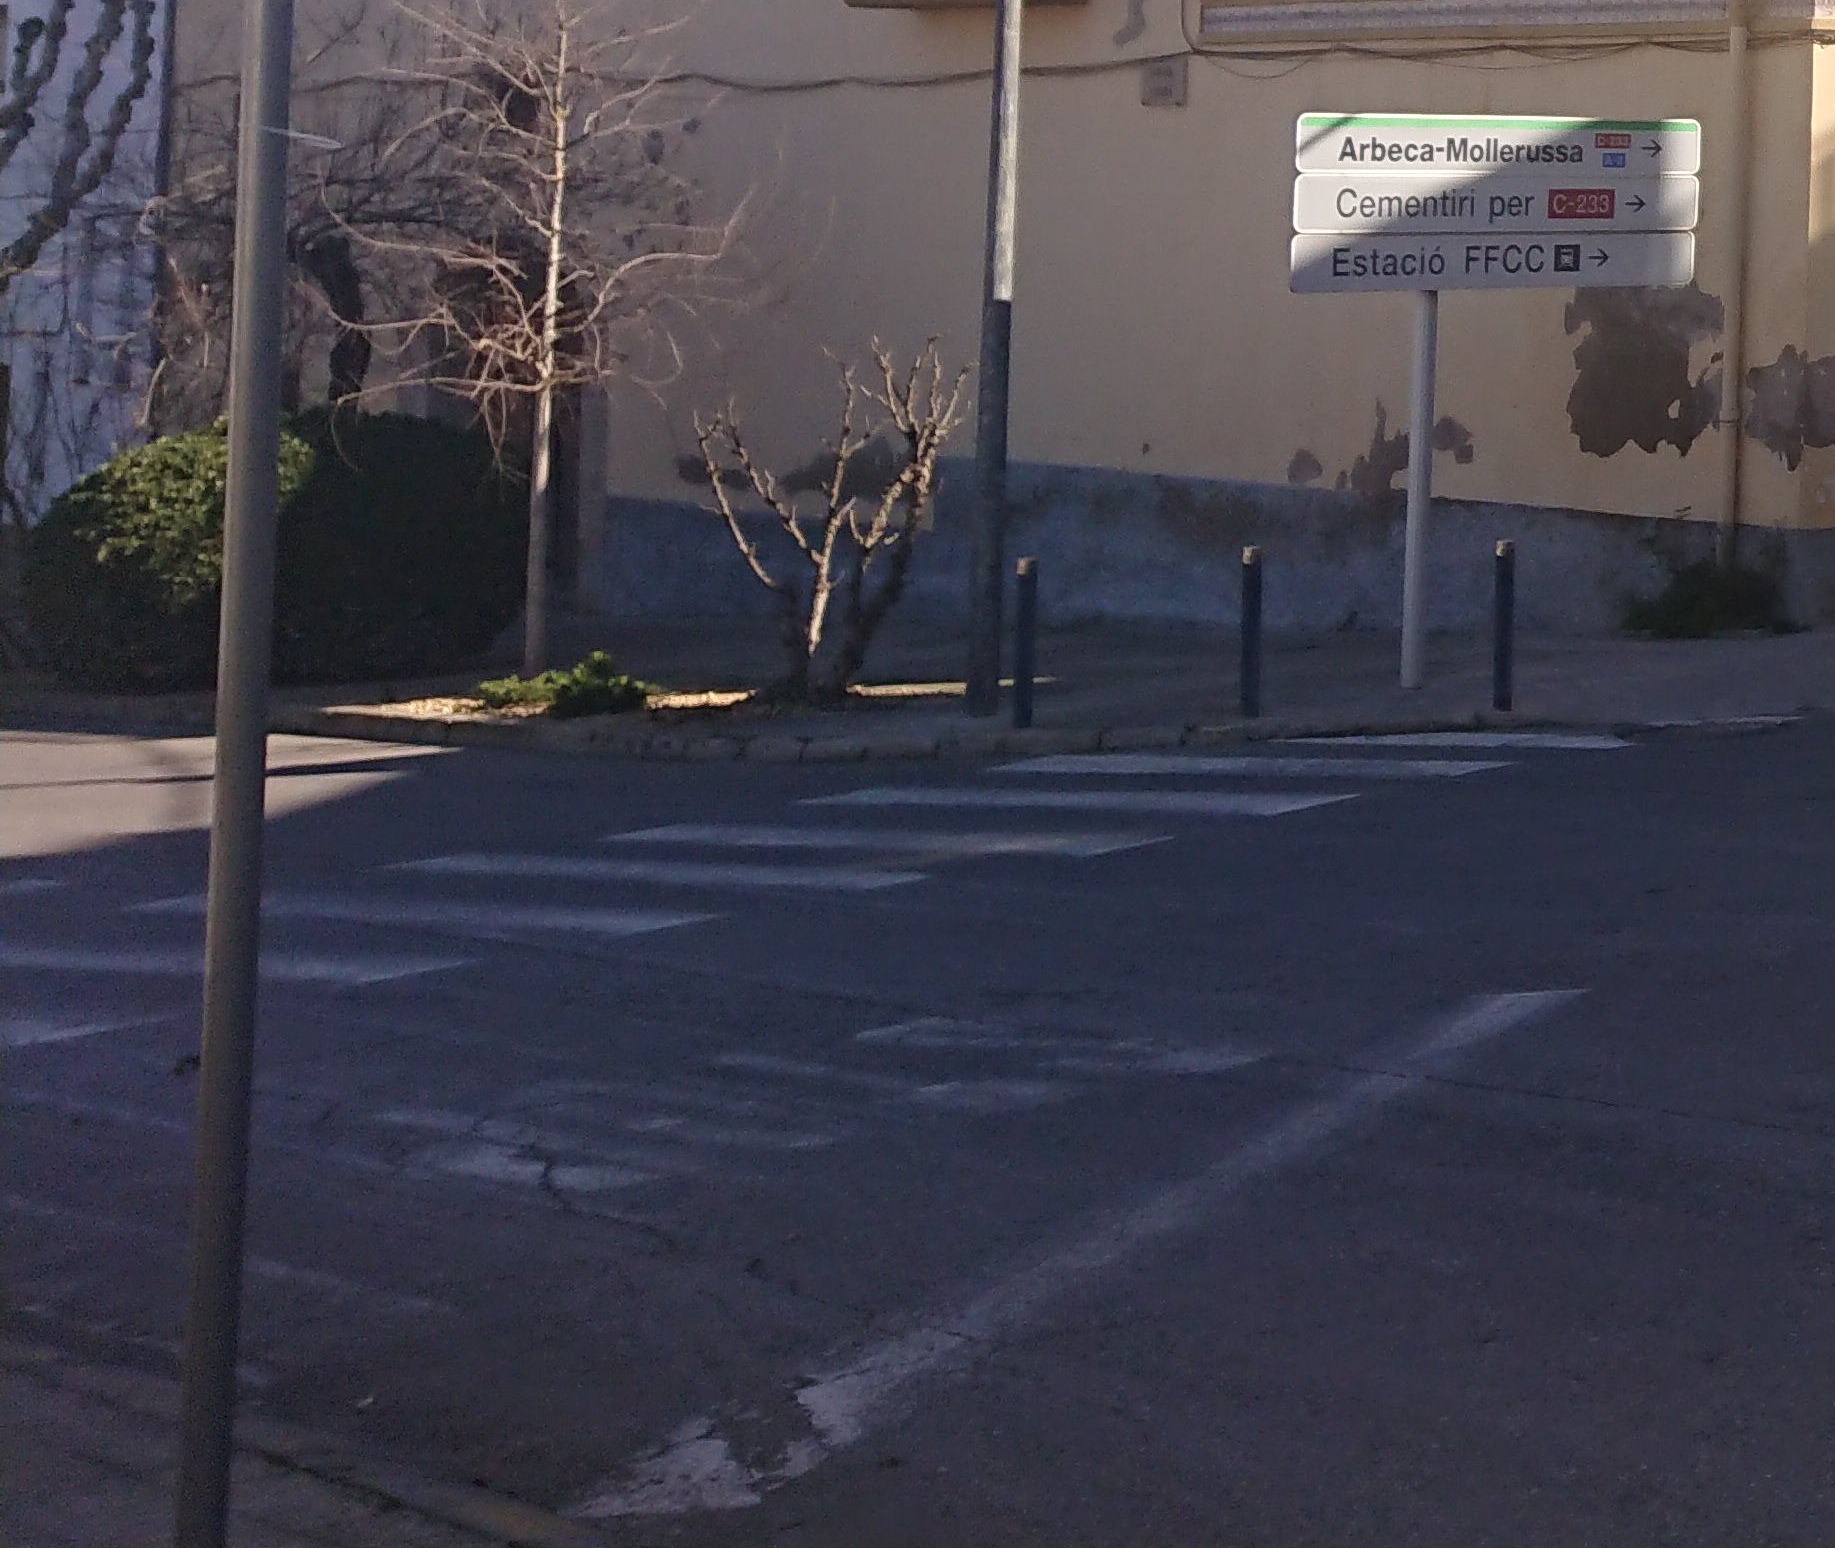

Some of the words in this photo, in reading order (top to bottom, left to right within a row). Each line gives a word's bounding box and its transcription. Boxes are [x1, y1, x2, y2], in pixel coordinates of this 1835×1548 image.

[1338, 136, 1584, 164] Arbeca-Mollerussa
[1336, 188, 1476, 219] Cementiri
[1488, 194, 1535, 223] per
[1552, 193, 1610, 214] C-233
[1331, 246, 1446, 277] Estació
[1464, 245, 1545, 273] FFCC
